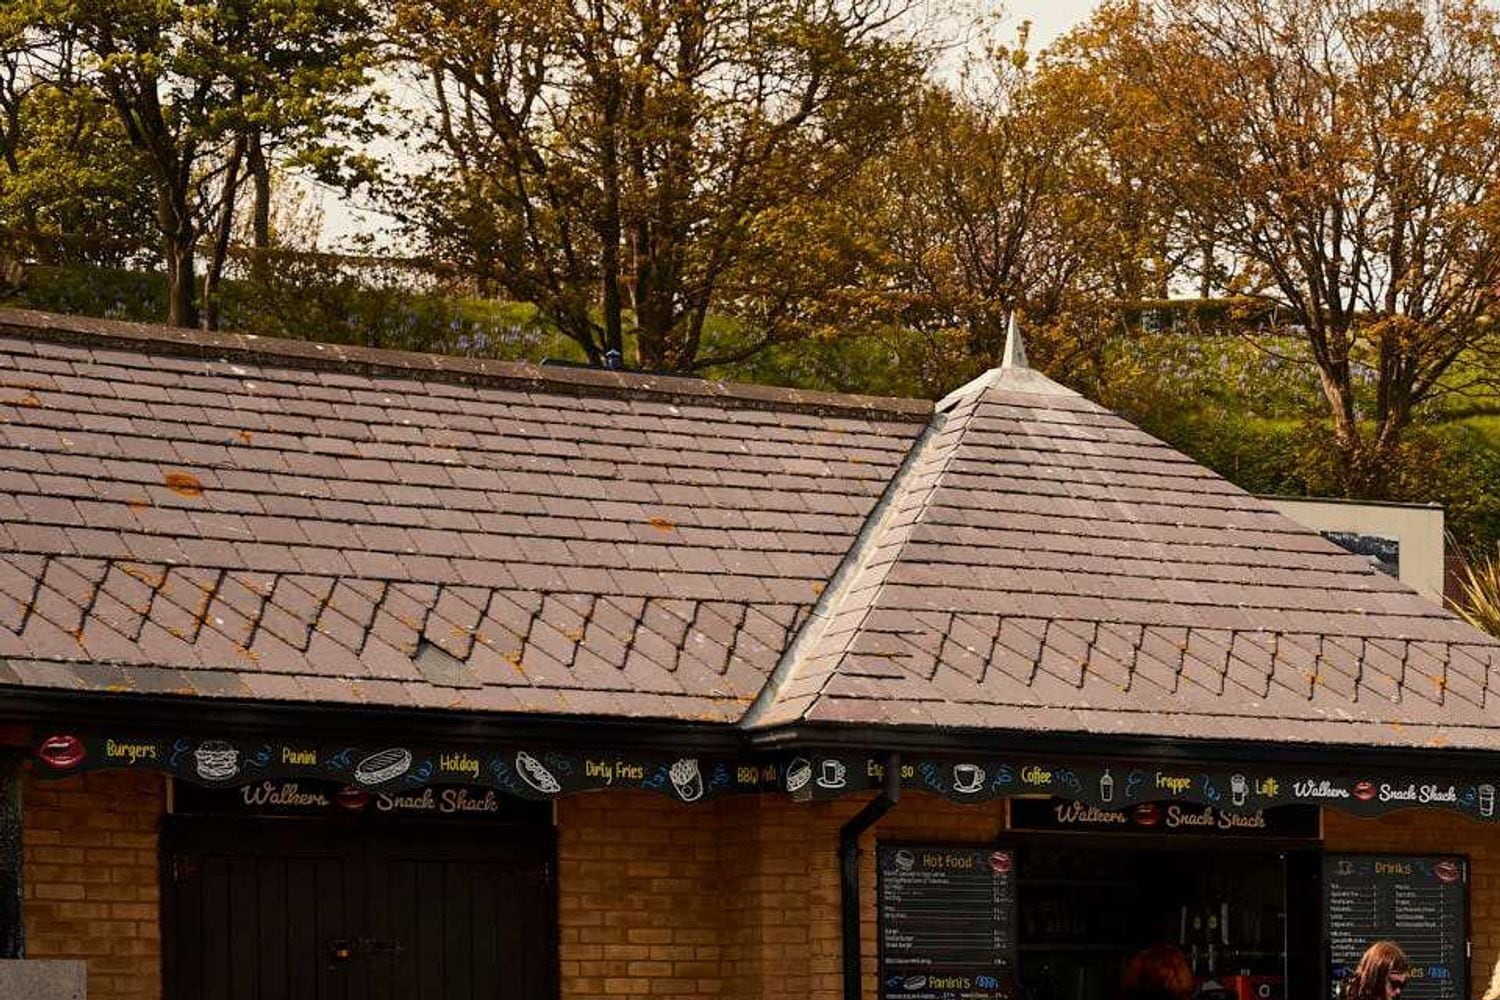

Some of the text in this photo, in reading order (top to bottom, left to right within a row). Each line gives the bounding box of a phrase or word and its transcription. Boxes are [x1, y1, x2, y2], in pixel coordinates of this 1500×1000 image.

[106, 739, 156, 764] Burgers
[283, 746, 317, 766] Panini
[440, 753, 480, 778] Hotdog
[586, 759, 644, 786] Dirty Fries
[737, 766, 759, 784] BBQ
[1021, 765, 1052, 785] Coffee
[1155, 772, 1191, 795] Frappe
[1293, 780, 1457, 803] Walkers Snack Shack
[241, 782, 499, 813] Walkers Snack Shack
[1166, 806, 1214, 828] Snack
